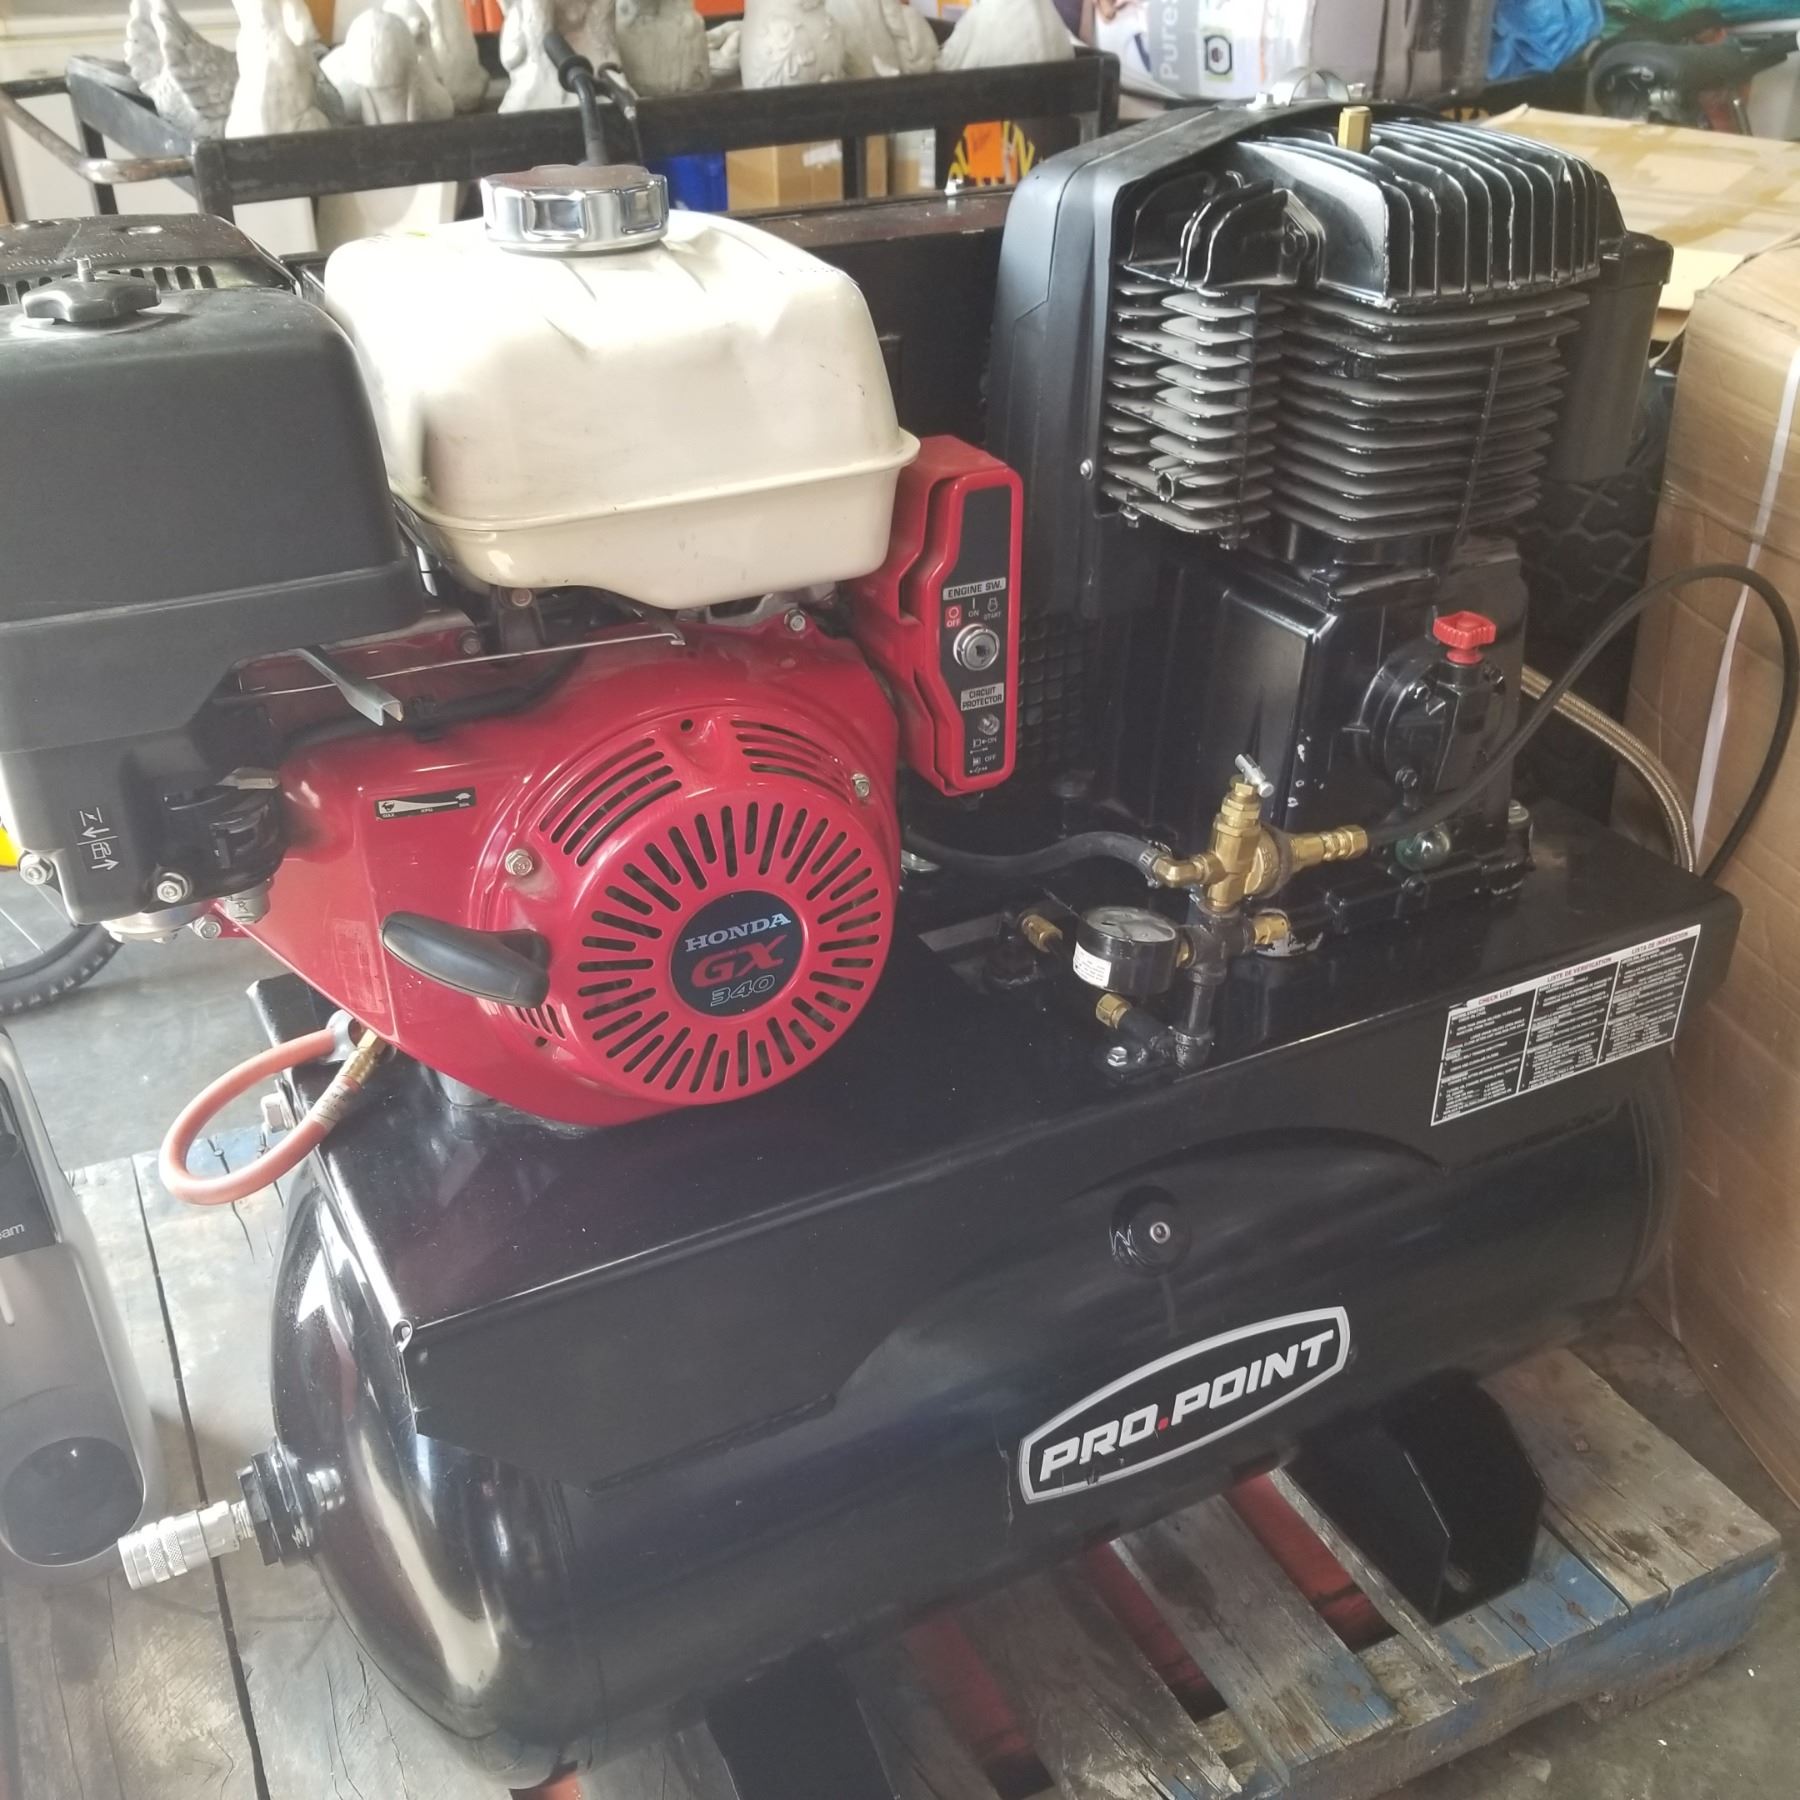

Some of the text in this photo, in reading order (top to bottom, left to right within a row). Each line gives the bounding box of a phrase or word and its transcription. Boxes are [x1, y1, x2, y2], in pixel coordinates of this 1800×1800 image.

[1159, 0, 1180, 80] Pure
[947, 579, 1003, 598] ENGINE SW.
[968, 610, 980, 618] ON
[946, 619, 961, 628] OFF
[962, 694, 1003, 709] PROTECTOR
[968, 686, 996, 699] CIRCUIT
[684, 912, 792, 953] HONDA
[690, 933, 788, 989] GX
[710, 973, 776, 1008] 340
[0, 1223, 25, 1240] am
